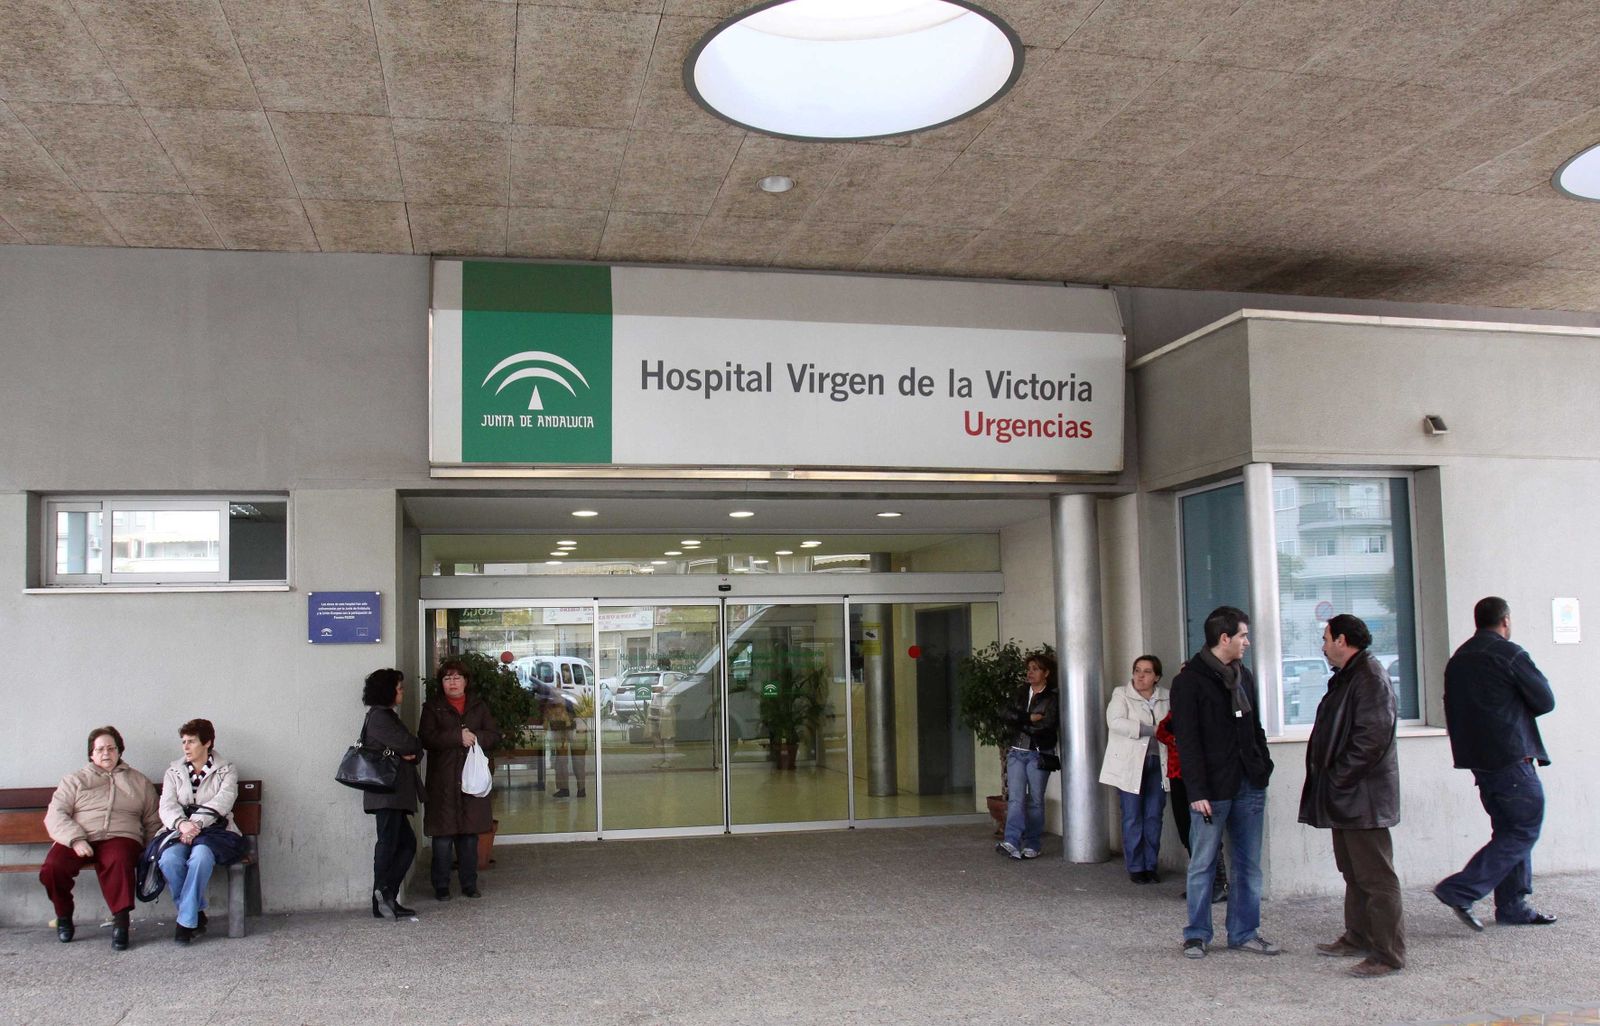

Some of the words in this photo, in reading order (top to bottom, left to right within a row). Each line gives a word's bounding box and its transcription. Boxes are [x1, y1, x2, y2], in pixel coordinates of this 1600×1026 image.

[642, 360, 772, 400] Hospital
[787, 363, 884, 402] Virgen
[899, 366, 935, 397] de
[949, 368, 973, 399] la
[985, 370, 1093, 403] Victoria
[480, 414, 515, 428] JUNTA
[520, 414, 533, 428] DE
[537, 415, 595, 428] ANDALUCIA
[965, 411, 1093, 444] Urgencias
